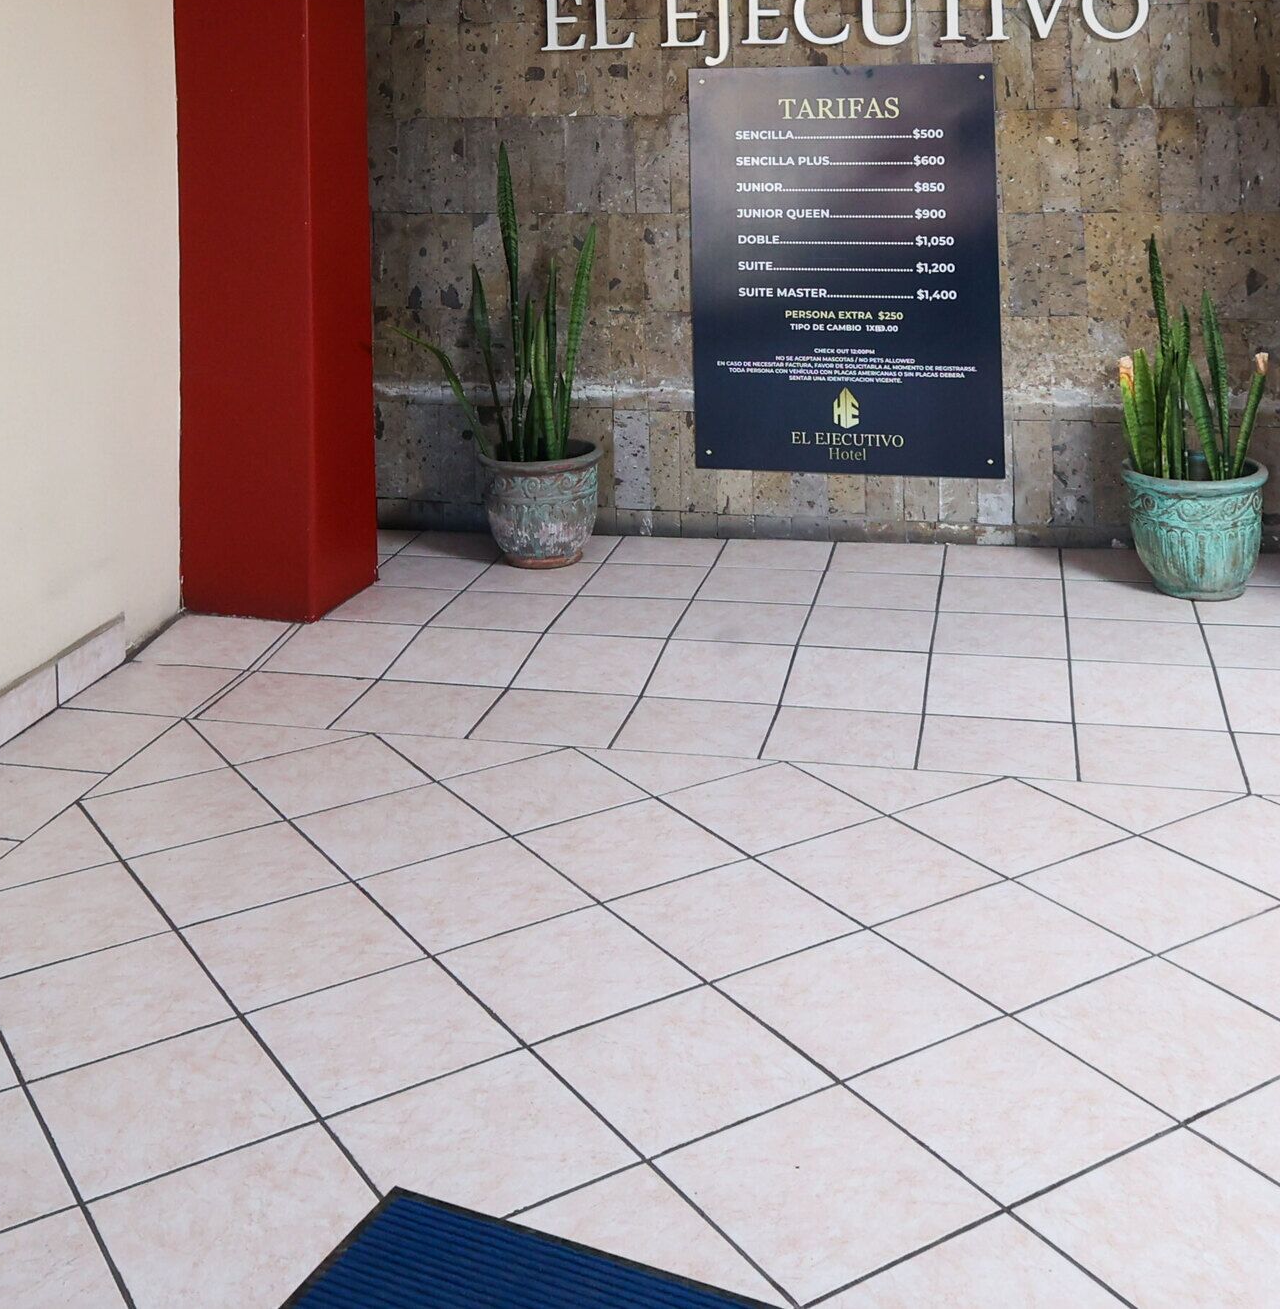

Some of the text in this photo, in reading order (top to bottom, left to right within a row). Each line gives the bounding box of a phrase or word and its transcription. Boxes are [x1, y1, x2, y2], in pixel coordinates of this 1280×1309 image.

[778, 97, 900, 120] TARIFAS
[735, 127, 944, 140] SENCILLA $500
[735, 154, 945, 167] SENCILLA PLUS $600
[736, 181, 945, 193] JUNIOR $850
[736, 208, 946, 220] JUNIOR QUEEN $900
[737, 234, 955, 247] DOBLE $1,050
[738, 261, 956, 274] SUITE $1,200
[738, 287, 957, 301] SUITE MASTER $1,400
[785, 310, 904, 321] PERSONA EXTRA $250
[790, 323, 810, 331] TIPO
[826, 324, 862, 332] CAMBIO
[791, 431, 905, 448] EL EJECUTIVO
[829, 447, 867, 461] Hotel
